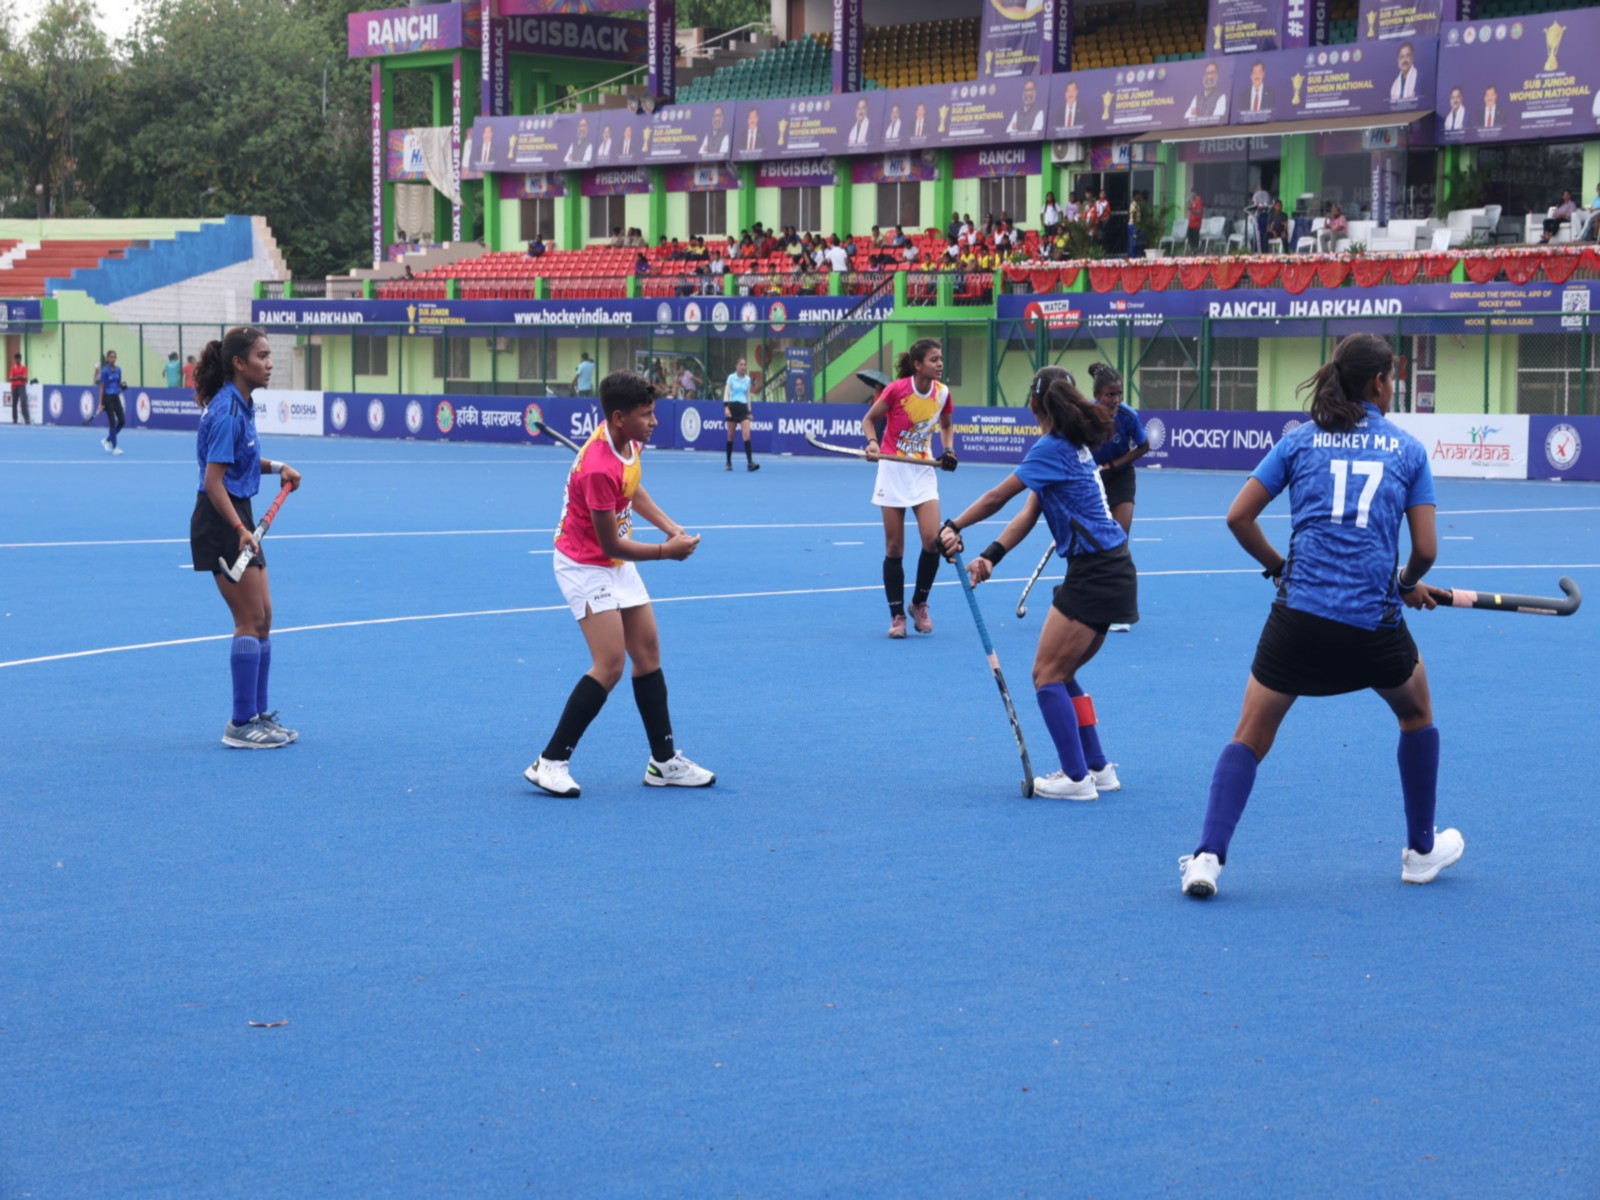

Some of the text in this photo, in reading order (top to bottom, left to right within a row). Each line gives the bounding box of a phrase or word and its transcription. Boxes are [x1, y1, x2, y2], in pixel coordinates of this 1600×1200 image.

[1380, 8, 1416, 19] SUB JUNIOR
[1380, 13, 1436, 26] WOMEN NATIONAL
[367, 13, 438, 46] RANCHI
[482, 6, 490, 81] #HEROHIL
[662, 17, 671, 97] #HEROHIL
[495, 27, 504, 115] #BIGISBACK
[1308, 76, 1322, 84] SUB
[1324, 72, 1350, 82] JUNIOR
[1524, 76, 1576, 90] SUB JUNIOR
[1307, 80, 1374, 93] WOMEN NATIONAL
[1510, 85, 1590, 101] WOMEN NATIONAL
[1116, 90, 1154, 101] SUB JUNIOR
[952, 106, 964, 114] SUB
[966, 104, 986, 114] JUNIOR
[1116, 98, 1175, 110] WOMEN NATIONAL
[951, 112, 1004, 123] WOMEN NATIONAL
[979, 149, 1026, 166] RANCHI
[453, 148, 461, 212] LAGUE
[373, 169, 381, 226] LEAGUE
[1450, 290, 1486, 299] DOWNLOAD
[1487, 290, 1499, 298] THE
[1500, 290, 1526, 298] OFFICIAL
[1044, 302, 1068, 312] WATCH
[1110, 300, 1126, 310] YouTube
[1286, 299, 1402, 318] JHARKHAND
[1478, 300, 1504, 308] HOCKEY
[302, 312, 364, 324] JHARKHAND
[514, 307, 633, 328] www.hockeyindia.org
[1088, 314, 1164, 327] HOCKY INDIA
[1464, 318, 1486, 326] HOCKE
[1509, 318, 1534, 326] LEAGUE
[290, 405, 316, 415] ODISHA
[456, 406, 522, 428] हॉकी झारखण्ड
[703, 421, 724, 430] GOVT.
[778, 418, 866, 438] RANCHI, JHAR
[981, 424, 1012, 434] WOMEN
[1171, 428, 1274, 449] HOCKEY INDIA
[1313, 432, 1402, 456] HOCKEY M.P.
[1432, 432, 1510, 461] Anandana
[1330, 459, 1384, 529] 17
